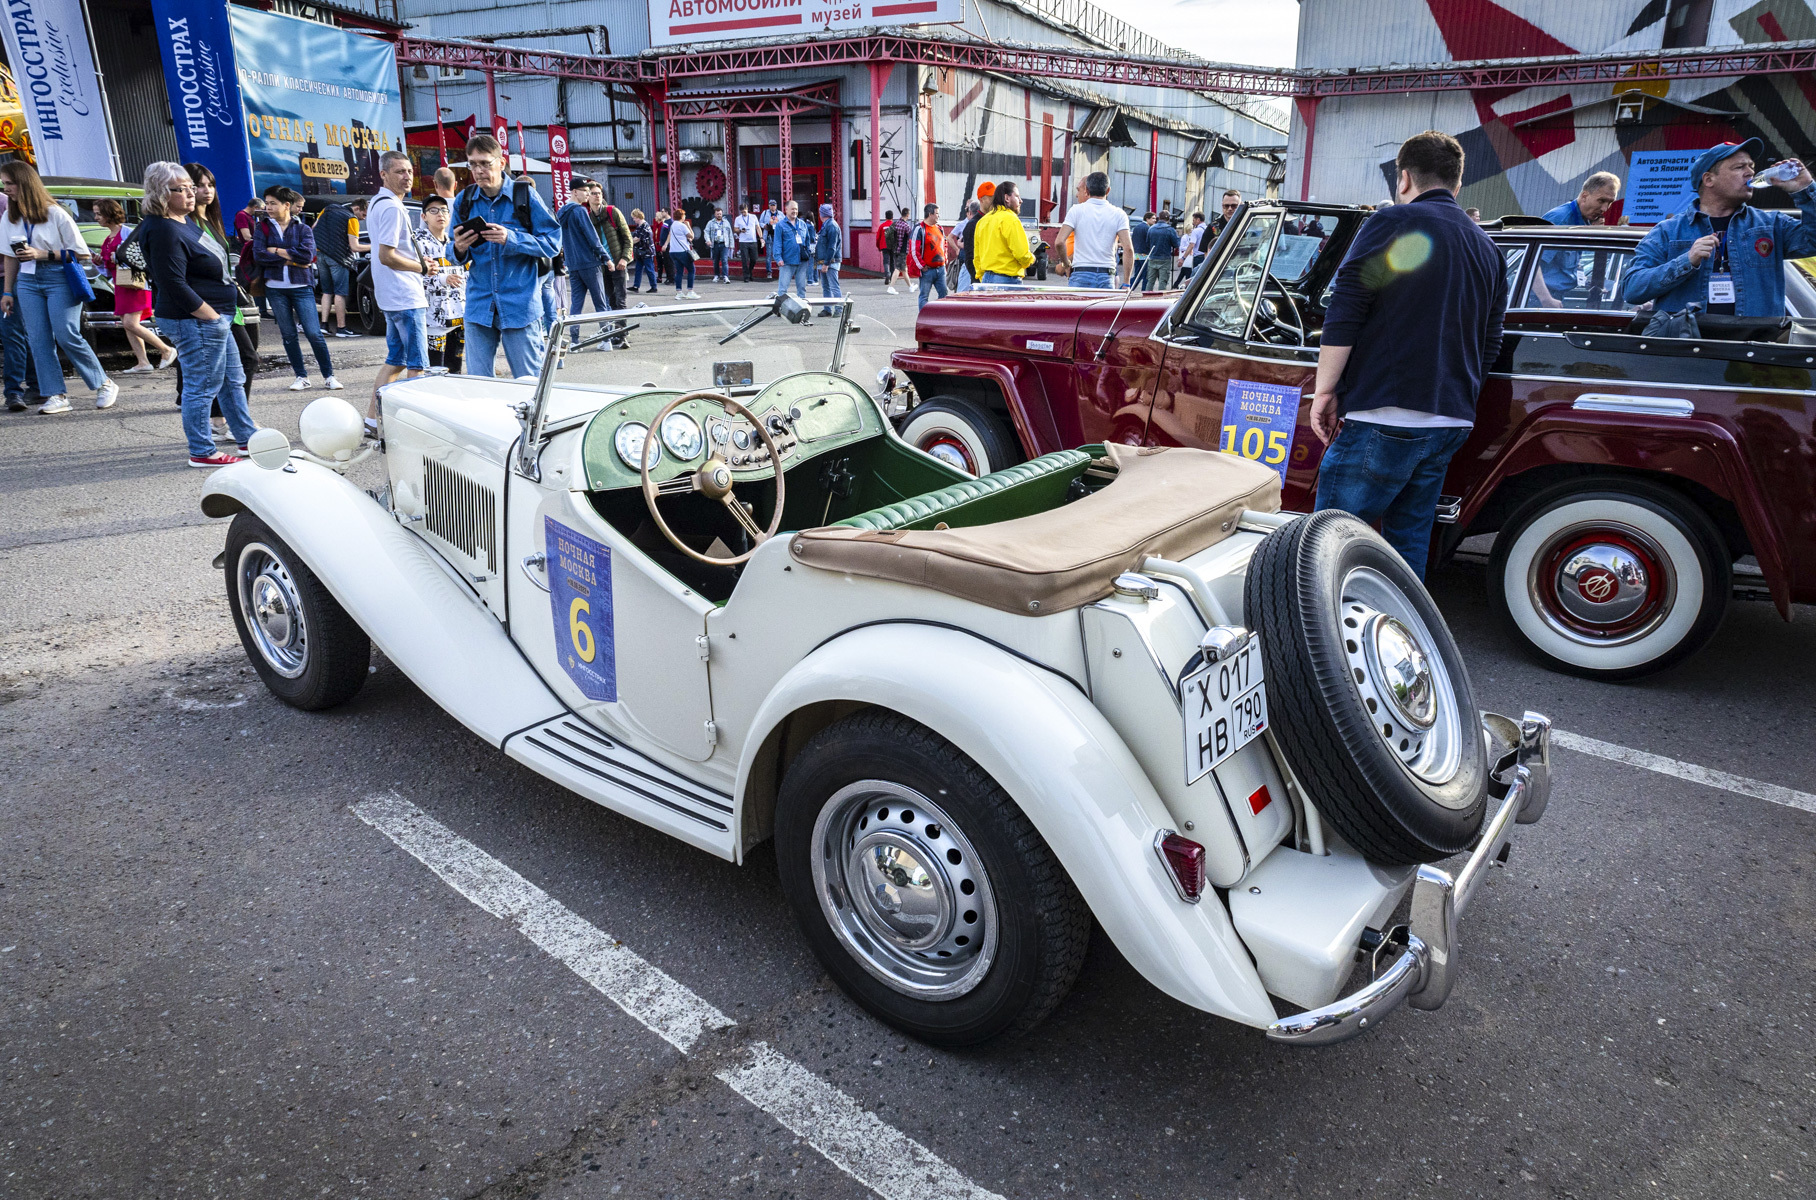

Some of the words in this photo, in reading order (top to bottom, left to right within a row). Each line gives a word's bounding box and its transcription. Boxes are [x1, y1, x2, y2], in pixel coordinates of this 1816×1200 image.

[812, 4, 862, 26] музей
[45, 20, 89, 116] Exclusive
[168, 17, 210, 148] ИНГОССТРАХ
[198, 40, 233, 126] Exclusive
[240, 68, 281, 88] О-РАЛЛИ
[283, 75, 340, 97] КЛАССИЧЕСКИХ
[343, 87, 388, 105] АВТОМОБИЛЕЙ
[248, 113, 316, 144] ОЧНАЯ
[324, 123, 390, 151] МОСКВА
[308, 161, 344, 176] 18.06.2022
[1637, 157, 1689, 165] Автозапчасти
[1660, 164, 1689, 172] Японии
[1240, 401, 1281, 415] МОСКВА
[1241, 390, 1283, 404] НОЧНАЯ
[1220, 424, 1288, 464] 105
[558, 537, 595, 569] НОЧНАЯ
[559, 554, 597, 586] МОСКВА
[569, 597, 596, 663] 6
[1219, 649, 1251, 702] 017
[1235, 691, 1262, 733] 790
[1243, 725, 1256, 740] RUS
